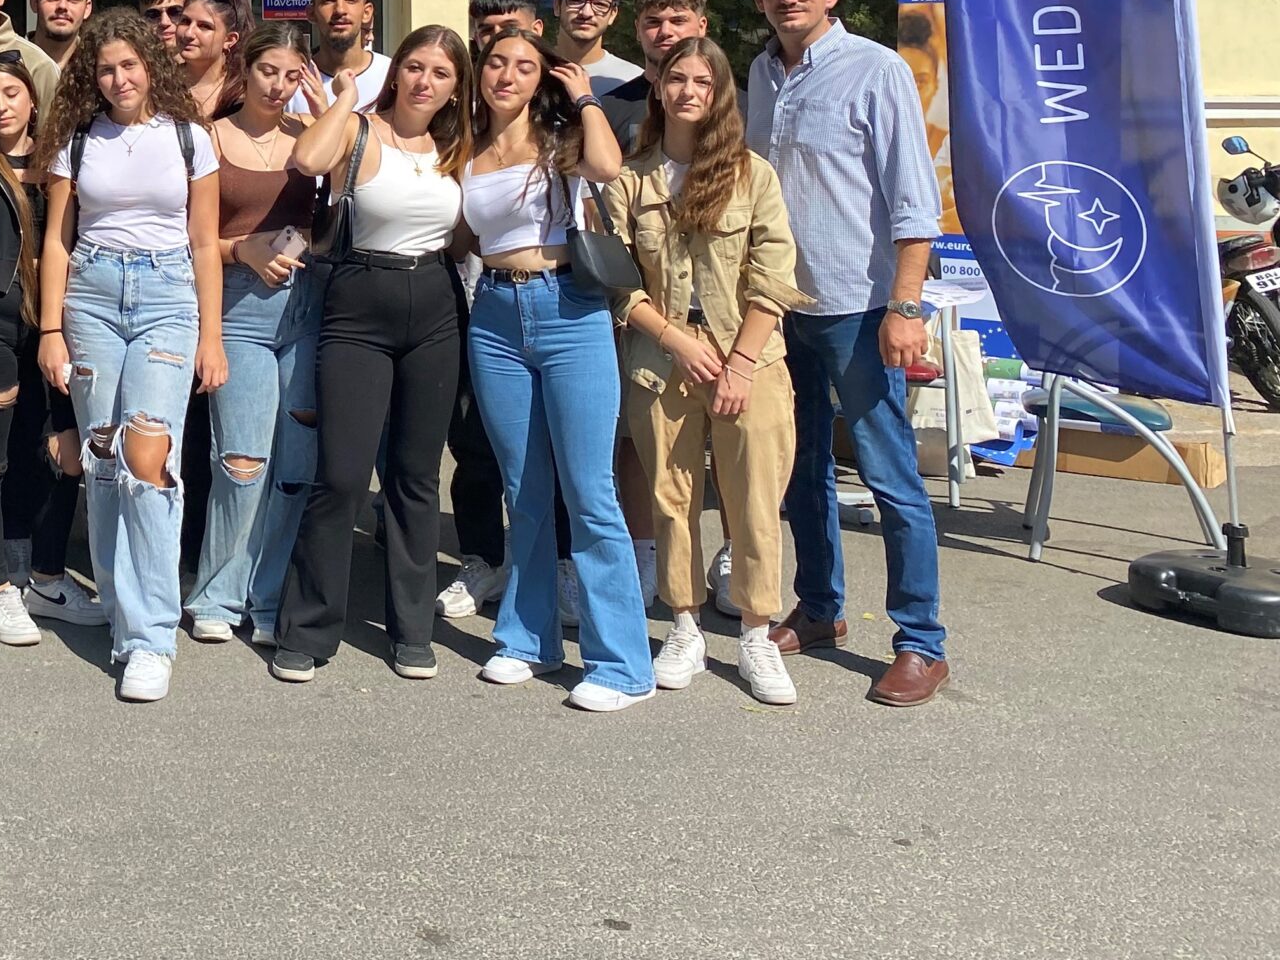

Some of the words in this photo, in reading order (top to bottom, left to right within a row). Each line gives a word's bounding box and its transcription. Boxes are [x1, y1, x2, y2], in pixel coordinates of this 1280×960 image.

[942, 265, 956, 274] 00
[959, 266, 981, 276] 800
[1256, 277, 1280, 289] 91
